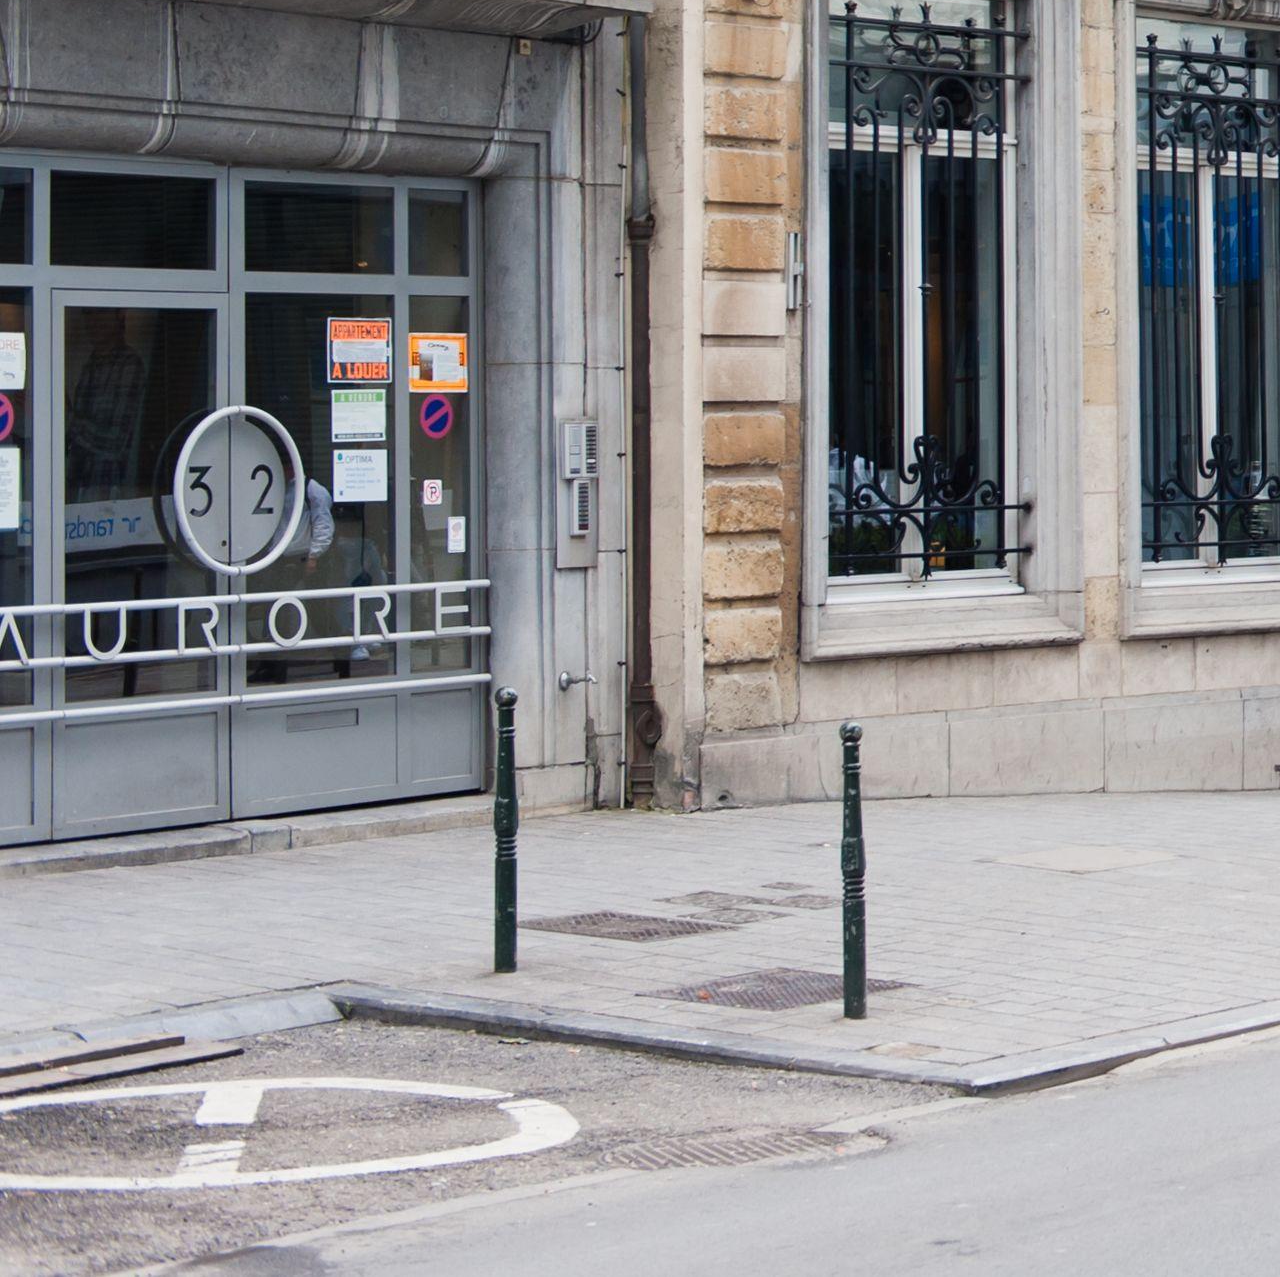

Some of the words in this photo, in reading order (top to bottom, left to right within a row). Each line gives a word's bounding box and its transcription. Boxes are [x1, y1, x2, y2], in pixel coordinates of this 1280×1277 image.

[332, 324, 388, 339] APPARTEMENT
[332, 363, 343, 379] A
[346, 363, 388, 379] LOUER
[345, 455, 373, 464] OPTIMA
[0, 585, 471, 665] AURORE
